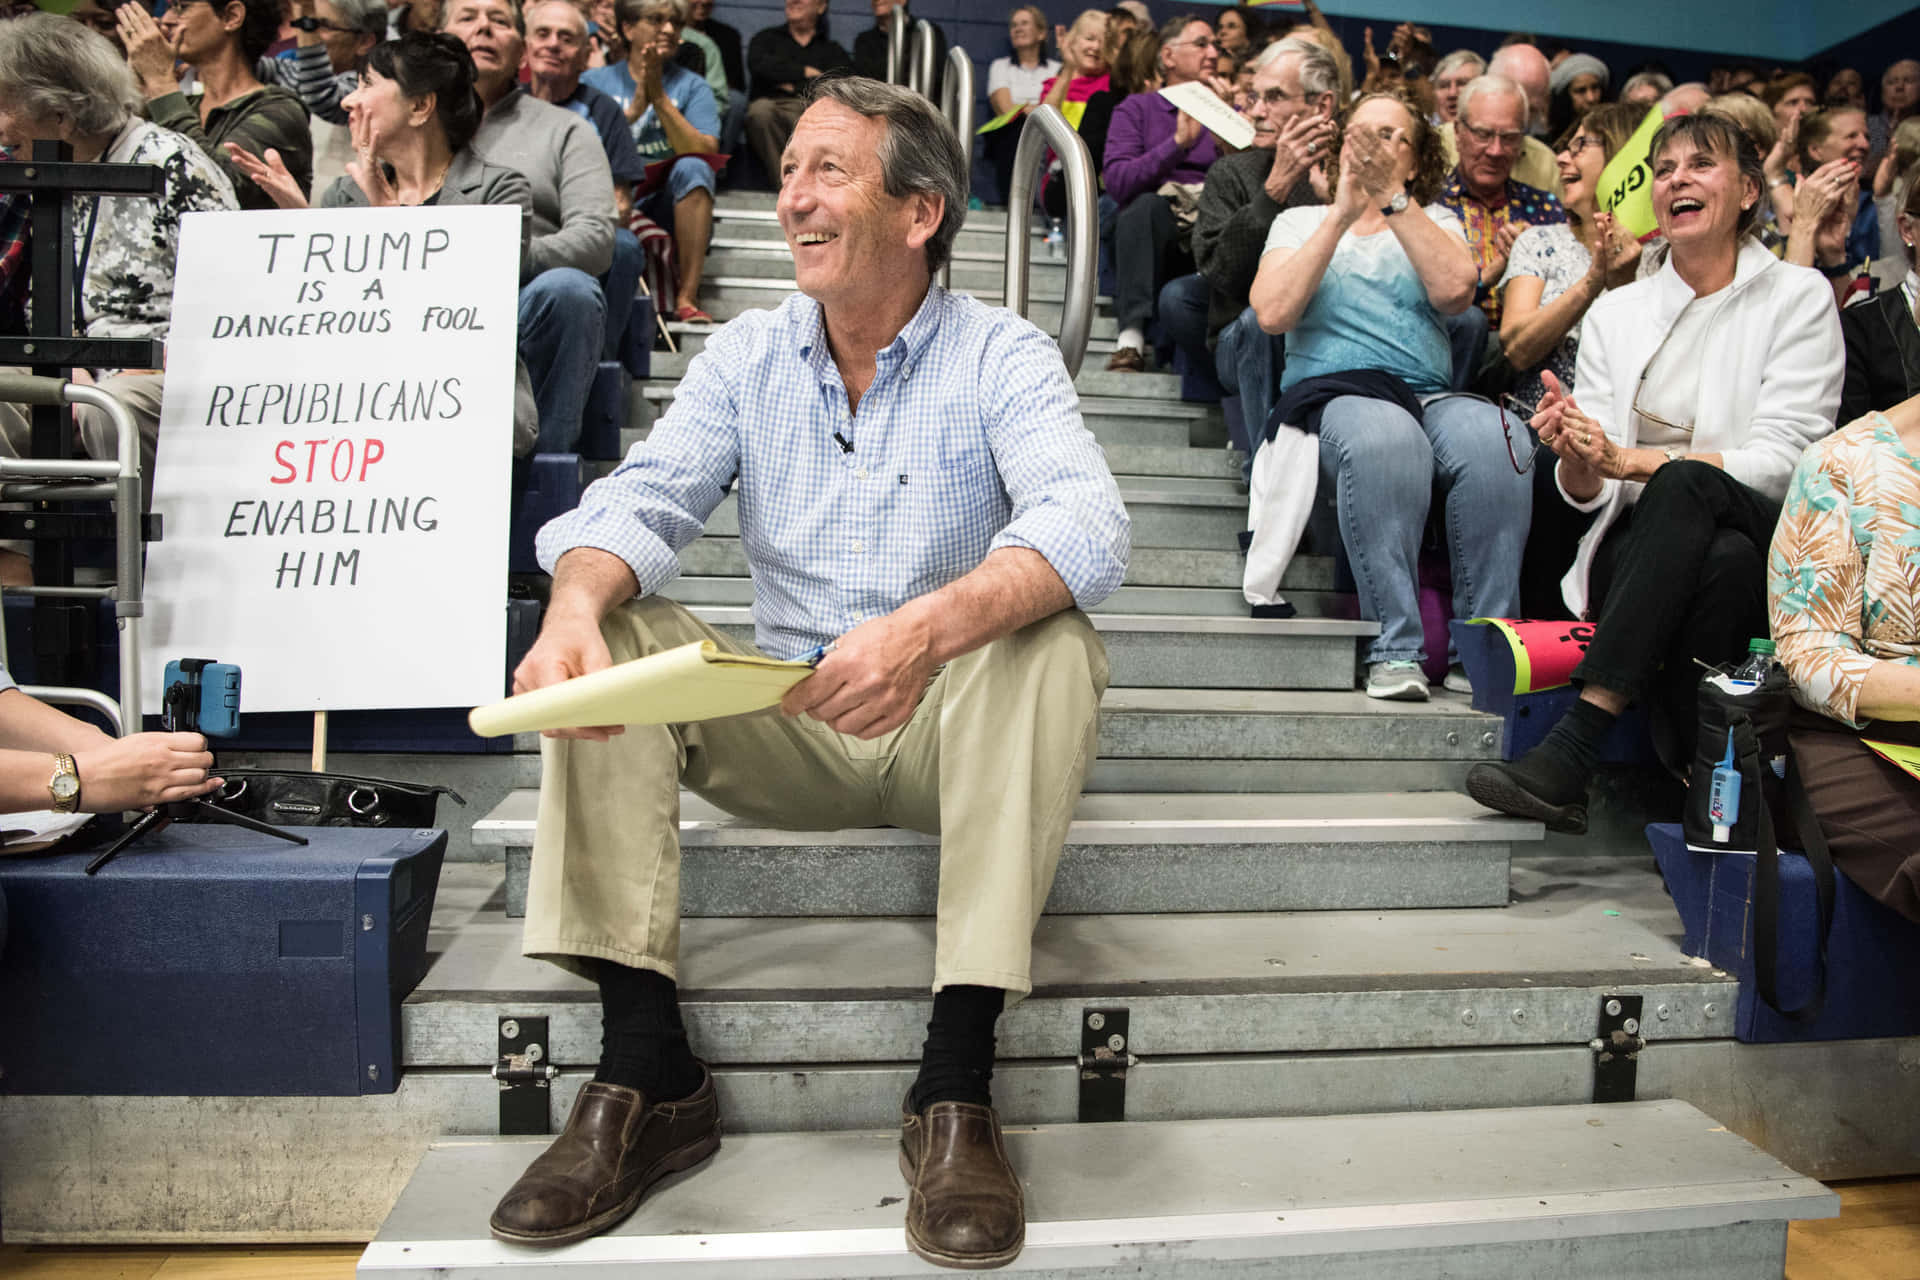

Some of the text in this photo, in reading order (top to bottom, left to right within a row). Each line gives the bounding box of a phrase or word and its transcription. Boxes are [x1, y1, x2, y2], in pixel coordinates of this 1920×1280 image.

[259, 229, 451, 275] TRUMP
[297, 279, 385, 304] IS A
[212, 307, 486, 339] DANGEROUS FOOL
[206, 378, 463, 427] REPUBLICANS
[270, 439, 386, 485] STOP
[224, 497, 439, 538] ENABLING
[276, 549, 361, 590] HIM
